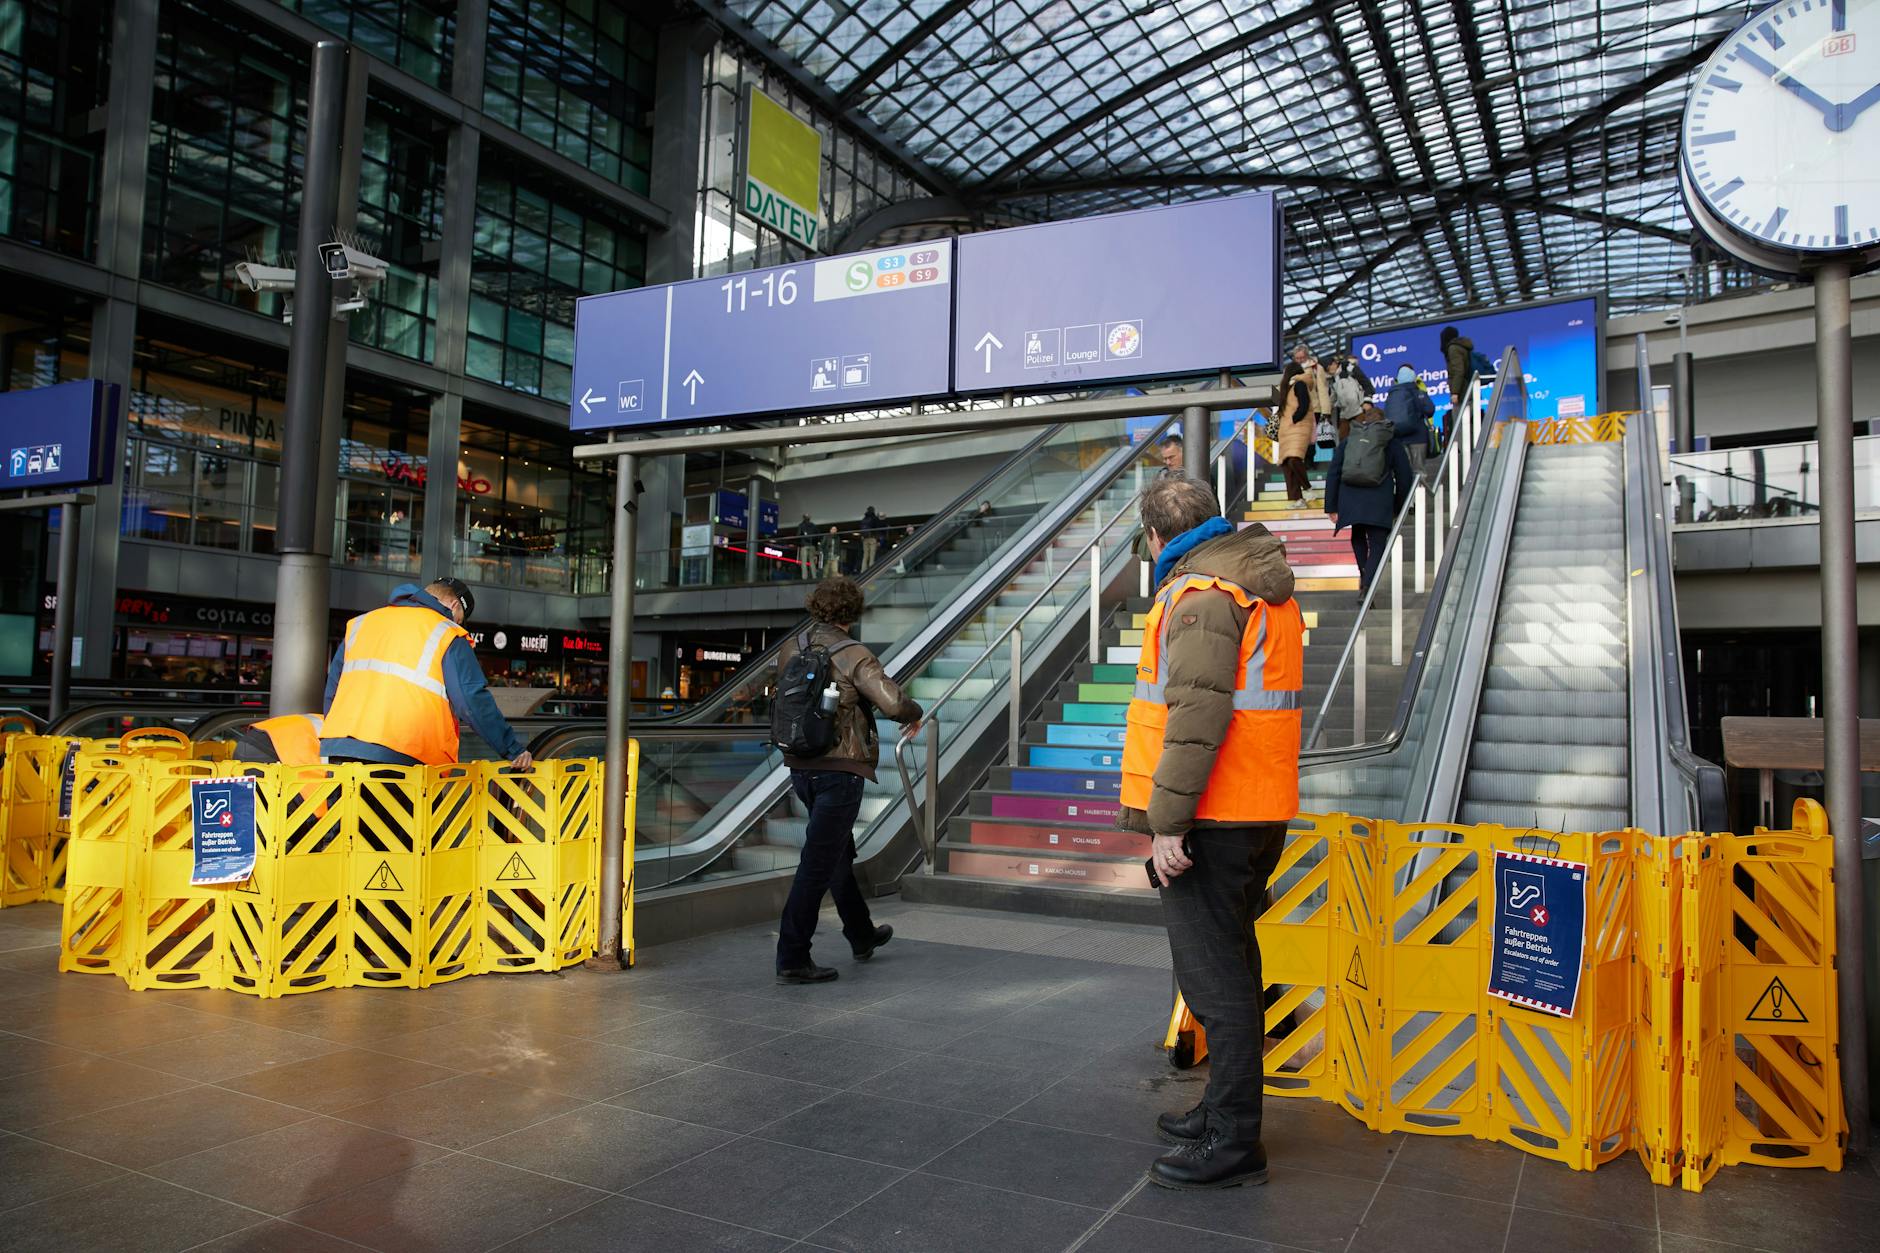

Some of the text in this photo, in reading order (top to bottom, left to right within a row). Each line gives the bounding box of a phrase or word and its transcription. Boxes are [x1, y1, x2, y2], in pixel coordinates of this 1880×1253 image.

[1828, 38, 1850, 53] DB
[746, 180, 818, 245] DATEV
[883, 251, 932, 268] S3 S7
[883, 269, 932, 285] S5 S9
[721, 269, 798, 313] 11-16
[1026, 349, 1098, 364] Polizei Lounge
[1383, 346, 1396, 355] can
[1397, 344, 1407, 353] do
[1370, 369, 1448, 388] Wir chen
[620, 395, 638, 409] WC
[219, 407, 276, 442] PINSA
[196, 607, 246, 624] COSTA
[703, 650, 742, 662] BURGER KING
[1504, 926, 1548, 943] Fahrtreppen
[1504, 937, 1553, 955] außer Betrieb
[1503, 948, 1529, 959] Escalators
[1538, 956, 1545, 964] of
